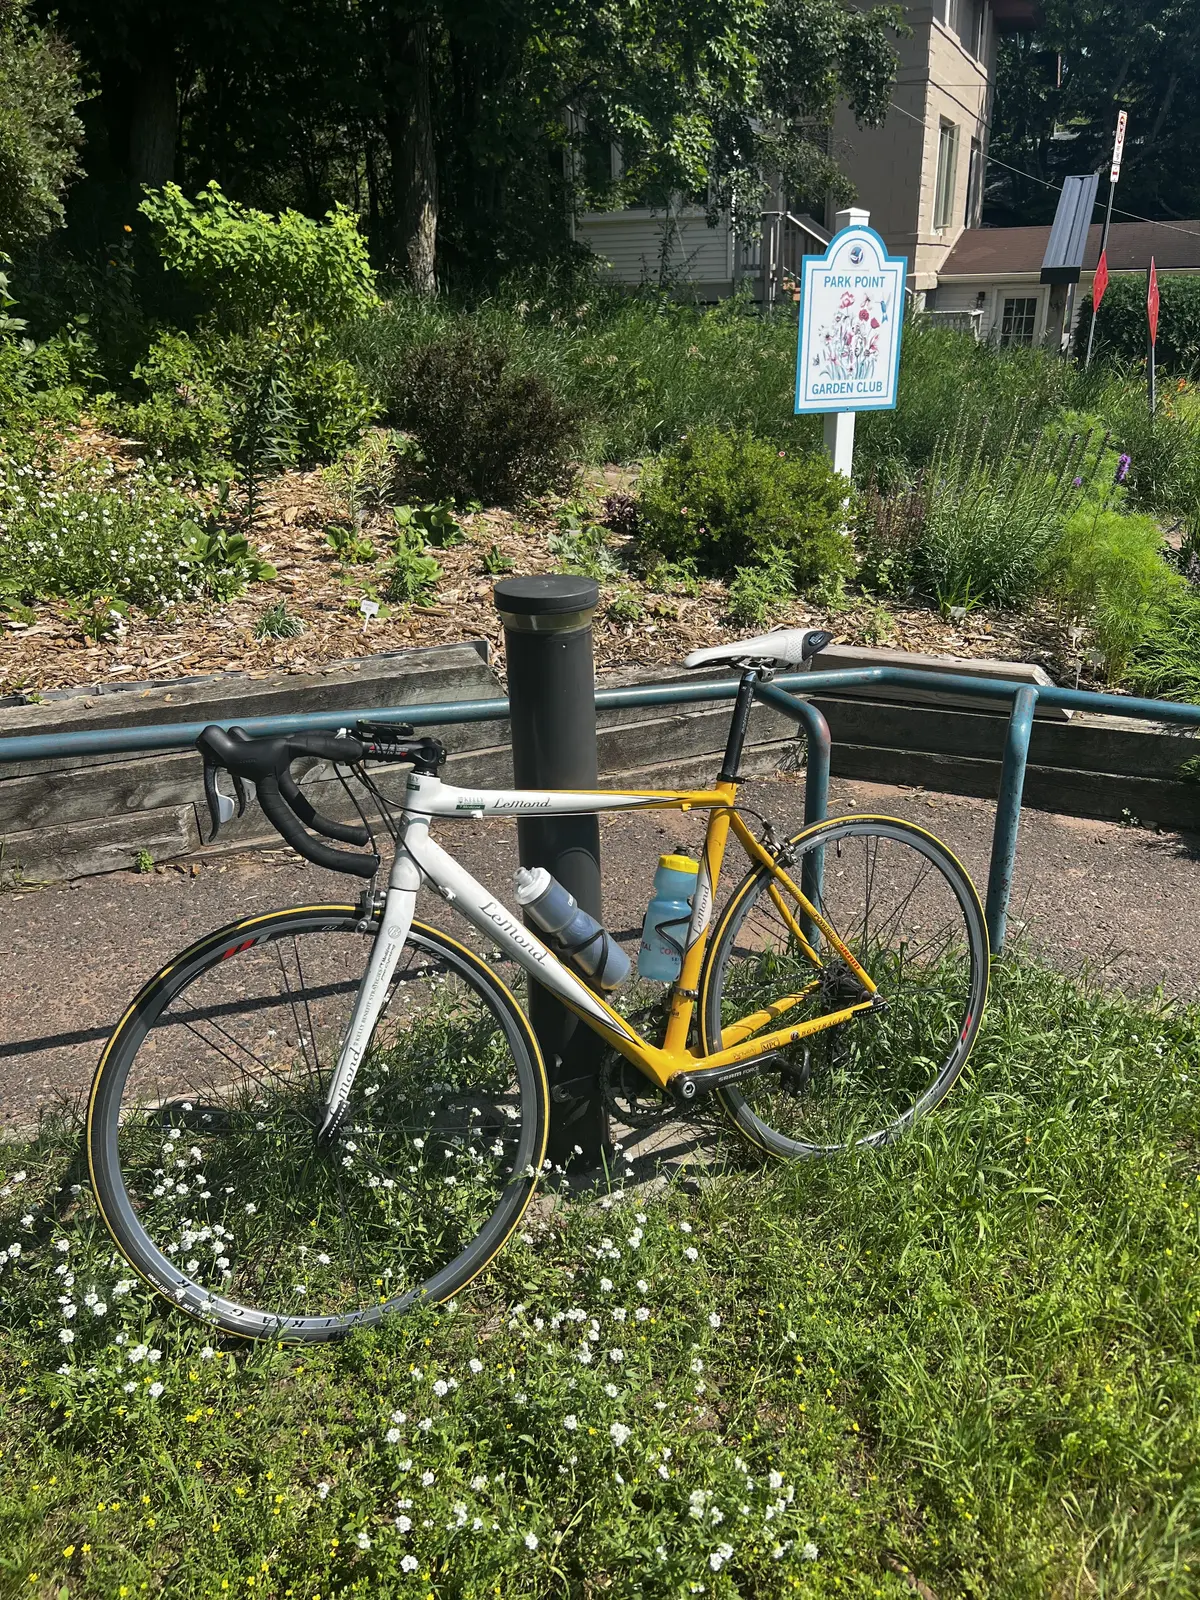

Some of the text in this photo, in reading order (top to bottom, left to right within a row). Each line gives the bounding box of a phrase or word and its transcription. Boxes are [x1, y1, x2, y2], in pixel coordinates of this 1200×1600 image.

[824, 275, 886, 288] PARK POINT
[811, 381, 883, 395] GARDEN CLUB
[492, 797, 552, 809] LeMond
[693, 884, 710, 935] LeMond
[479, 901, 546, 966] LeMond
[839, 943, 860, 970] SRAM
[354, 1022, 365, 1041] KELLY
[362, 1000, 373, 1022] BENEFIT
[801, 1015, 848, 1036] BONTRAGER
[718, 1066, 760, 1082] SRAM FORCE
